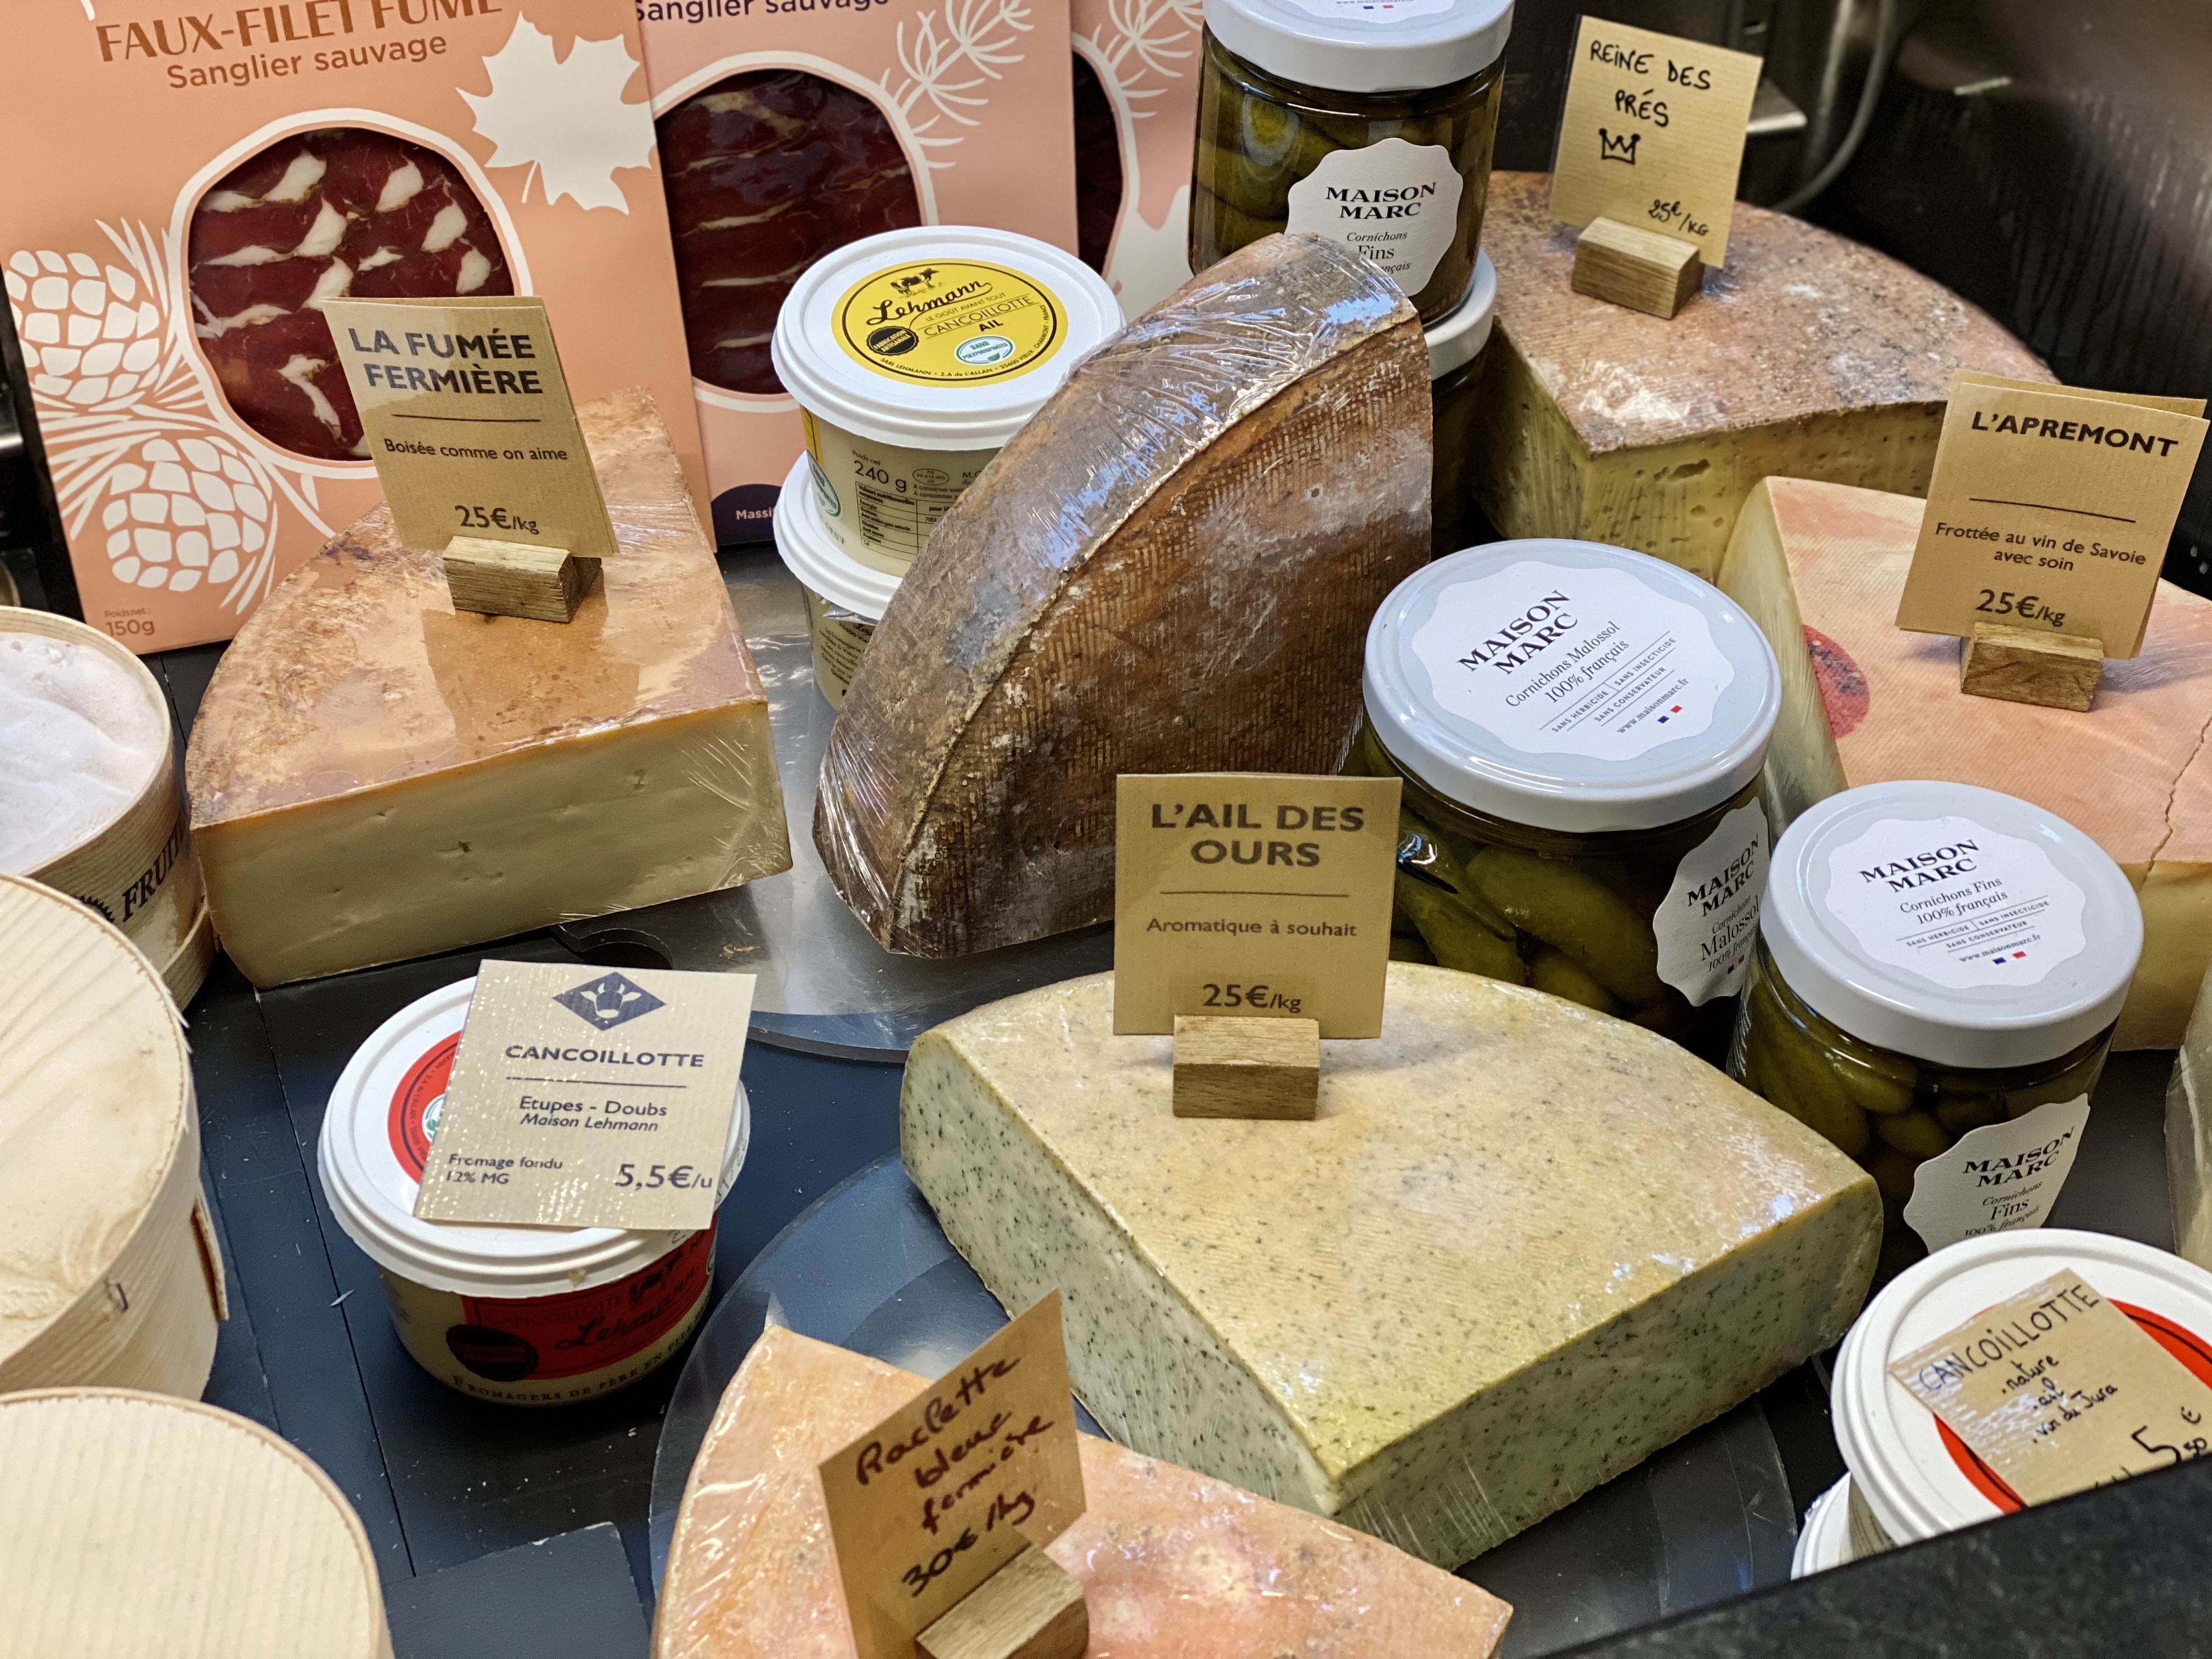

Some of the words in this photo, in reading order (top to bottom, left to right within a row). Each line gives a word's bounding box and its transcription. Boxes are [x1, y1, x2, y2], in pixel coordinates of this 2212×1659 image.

[167, 54, 302, 88] Sanglier
[314, 35, 447, 71] sauvage
[1668, 59, 1711, 90] DES
[1615, 88, 1669, 127] PRÉS
[1325, 182, 1437, 203] MAISON
[1339, 202, 1421, 219] MARC
[1347, 232, 1408, 242] Cornichons
[1357, 245, 1395, 260] Fins
[1381, 261, 1412, 275] nçais
[866, 280, 993, 325] Lehmann
[924, 296, 1035, 336] CANCOILLOTTE
[935, 307, 960, 319] GOÛT
[960, 298, 985, 311] AVANT
[986, 292, 1007, 303] TOUT
[979, 319, 1004, 332] AIL
[348, 328, 400, 355] LA
[404, 328, 536, 359] FUMÉE
[363, 363, 544, 394] FERMIÈRE
[880, 357, 895, 366] SARL
[895, 364, 932, 375] LEHMANN
[384, 438, 436, 456] Boisée
[440, 444, 498, 460] comme
[503, 449, 524, 460] on
[529, 447, 568, 461] aime
[1971, 411, 2179, 458] L'APREMONT
[854, 460, 889, 484] 240
[895, 478, 907, 493] g
[454, 505, 540, 535] 25€/kg
[736, 507, 775, 520] Massi
[1935, 522, 2000, 542] Frottée
[2006, 532, 2026, 545] au
[2033, 534, 2057, 549] vin
[2063, 538, 2085, 554] de
[2089, 542, 2147, 566] Savoie
[1994, 550, 2033, 566] avec
[2039, 555, 2074, 572] soin
[1975, 589, 2066, 628] 25€/kg
[105, 619, 155, 636] 150g
[1456, 589, 1571, 672] MAISON
[1492, 612, 1578, 675] MARC
[1505, 659, 1572, 707] Cornichons
[1566, 620, 1621, 663] Malossol
[1544, 673, 1585, 704] 100%
[1580, 640, 1629, 680] français
[1551, 717, 1572, 733] SANS
[1570, 689, 1609, 719] HERBICIDE
[1614, 671, 1634, 686] SANS
[1632, 637, 1677, 673] INSECTICIDE
[1594, 707, 1615, 722] SANS
[1613, 665, 1667, 708] CONSERVATEUR
[1616, 678, 1690, 734] www.maisonmarc.fr
[1152, 803, 1261, 829] L'AIL
[1276, 804, 1364, 832] DES
[1190, 839, 1321, 867] OURS
[1859, 839, 1980, 883] MAISON
[1686, 833, 1759, 907] MAISON
[1886, 858, 1977, 893] MARC
[1701, 860, 1754, 917] MARC
[1899, 887, 1973, 913] Cornichons
[1974, 877, 2003, 894] Fins
[1916, 906, 1955, 925] 100%
[1955, 890, 2008, 916] français
[1146, 917, 1262, 936] Aromatique
[1271, 919, 1280, 934] à
[1287, 921, 1357, 937] souhait
[1700, 894, 1759, 962] Malossol
[1906, 937, 1927, 947] SANS
[1928, 924, 1971, 941] HERBICIDE
[1978, 917, 1999, 927] SANS
[2000, 900, 2050, 921] INSECTICIDE
[1946, 939, 1967, 949] SANS
[1968, 920, 2028, 942] CONSERVATEUR
[1959, 933, 2042, 962] www.maisonmarc.fr
[1202, 983, 1302, 1014] 25€/kg
[505, 1045, 704, 1067] CANCOILLOTTE
[520, 1096, 583, 1113] Etupes
[604, 1100, 667, 1116] Doubs
[520, 1113, 579, 1128] Maison
[584, 1116, 659, 1132] Lehmann
[447, 1153, 514, 1170] Fromage
[519, 1156, 563, 1170] fondu
[1962, 1125, 2075, 1174] MAISON
[445, 1170, 476, 1184] 12%
[481, 1172, 510, 1184] MG
[614, 1163, 713, 1191] 5,5€/u
[1976, 1149, 2060, 1188] MARC
[1990, 1199, 2030, 1221] Fins
